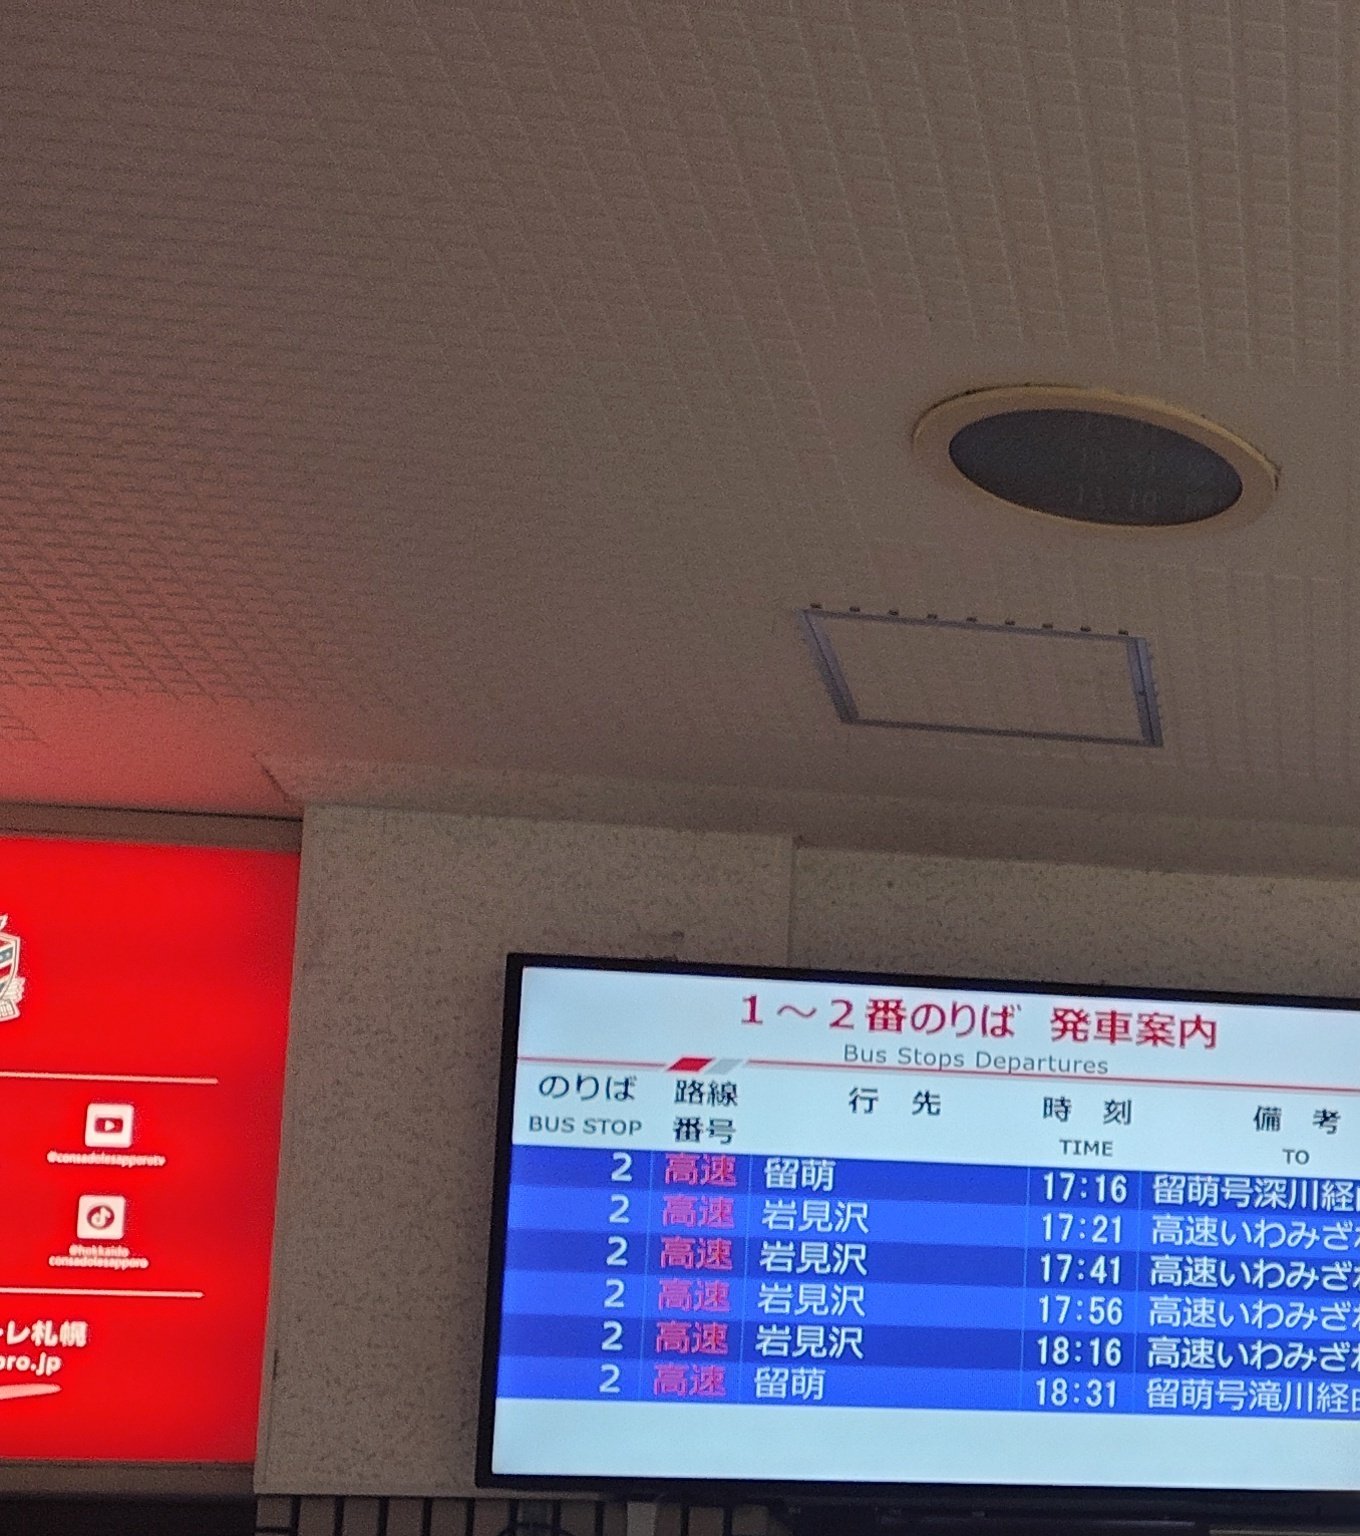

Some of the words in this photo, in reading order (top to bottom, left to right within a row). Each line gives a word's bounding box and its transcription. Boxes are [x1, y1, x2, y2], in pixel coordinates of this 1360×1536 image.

[1050, 1007, 1217, 1049] 発車案内
[843, 1044, 887, 1065] Bus
[897, 1047, 965, 1069] Stops
[975, 1050, 1108, 1075] Departures
[538, 1074, 637, 1101] のりば
[675, 1080, 738, 1107] 路線
[529, 1116, 575, 1134] BUS
[583, 1118, 643, 1136] STOP
[674, 1118, 736, 1144] 番号
[1060, 1141, 1114, 1157] TIME
[1283, 1149, 1310, 1166] TO
[665, 1153, 737, 1188] 高速
[764, 1159, 836, 1192] 留萌
[1042, 1173, 1127, 1203] 17:16
[662, 1195, 735, 1229] 高速
[762, 1201, 870, 1234] 岩見沢
[1042, 1214, 1122, 1244] 17:21
[660, 1237, 733, 1271] 高速
[760, 1242, 868, 1276] 岩見沢
[1040, 1255, 1121, 1285] 17:41
[658, 1279, 730, 1313] 高速
[758, 1285, 865, 1317] 岩見沢
[1039, 1296, 1123, 1326] 17:56
[0, 1320, 88, 1348] レ札幌
[656, 1321, 728, 1355] 高速
[755, 1326, 863, 1359] 岩見沢
[1037, 1336, 1122, 1367] 18:16
[653, 1363, 727, 1397] 高速
[754, 1368, 826, 1400] 留萌
[1036, 1377, 1117, 1408] 18:31
